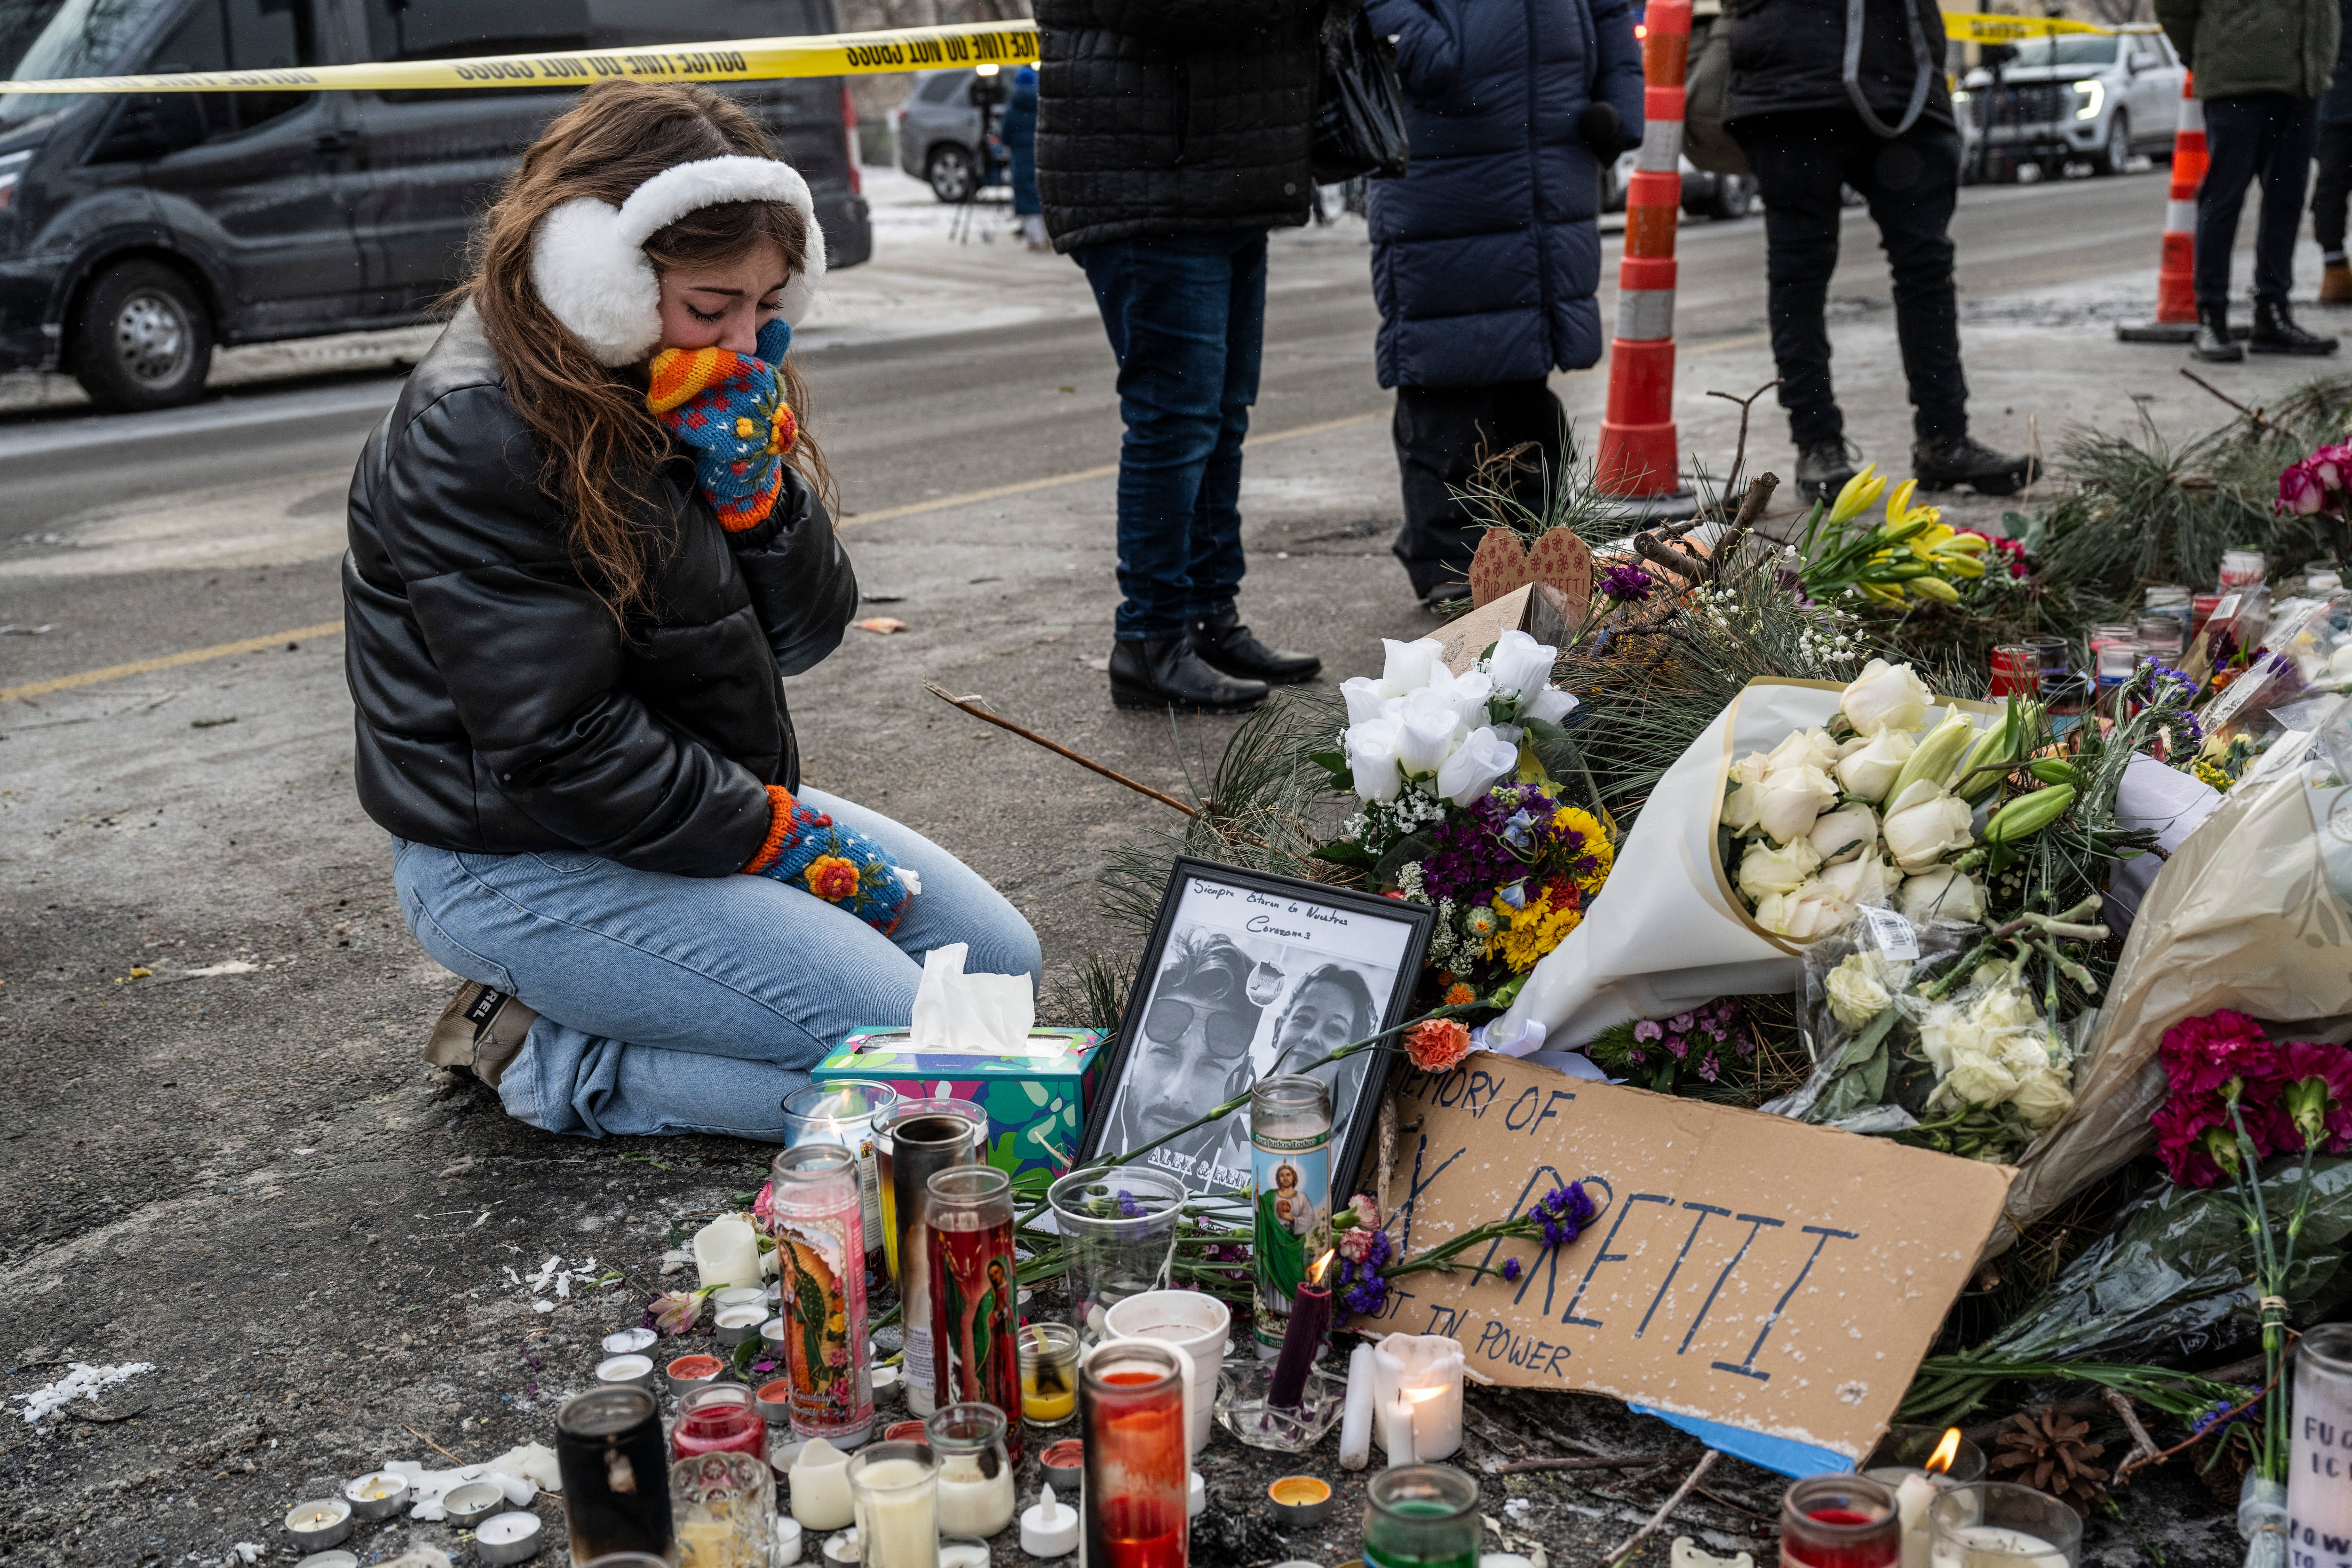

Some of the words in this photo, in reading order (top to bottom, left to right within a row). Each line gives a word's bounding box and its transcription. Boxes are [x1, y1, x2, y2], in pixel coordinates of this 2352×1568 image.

[839, 40, 904, 66] CROSS
[904, 35, 943, 63] NOT
[942, 33, 970, 61] DO
[972, 32, 1008, 60] LINE
[455, 60, 535, 80] CROSS
[537, 57, 588, 78] NOT
[587, 56, 623, 75] DO
[631, 54, 676, 74] LINE
[677, 51, 746, 73] POLICE
[1484, 579, 1500, 604] RIP
[1246, 915, 1311, 939] Corazones
[472, 989, 499, 1018] REL
[1391, 1054, 1505, 1119] MEMORY
[1506, 1086, 1576, 1136] OF
[1255, 1134, 1269, 1146] San
[1268, 1138, 1291, 1148] Judas
[1291, 1138, 1316, 1148] Tadeo
[1147, 1146, 1196, 1176] ALEX
[1196, 1160, 1211, 1180] &
[1212, 1164, 1251, 1190] REN
[1471, 1165, 1859, 1382] PRETTI
[1370, 1286, 1415, 1320] ST
[1421, 1304, 1469, 1338] IN
[1476, 1321, 1571, 1377] POWER
[795, 1388, 839, 1407] Guadalupe
